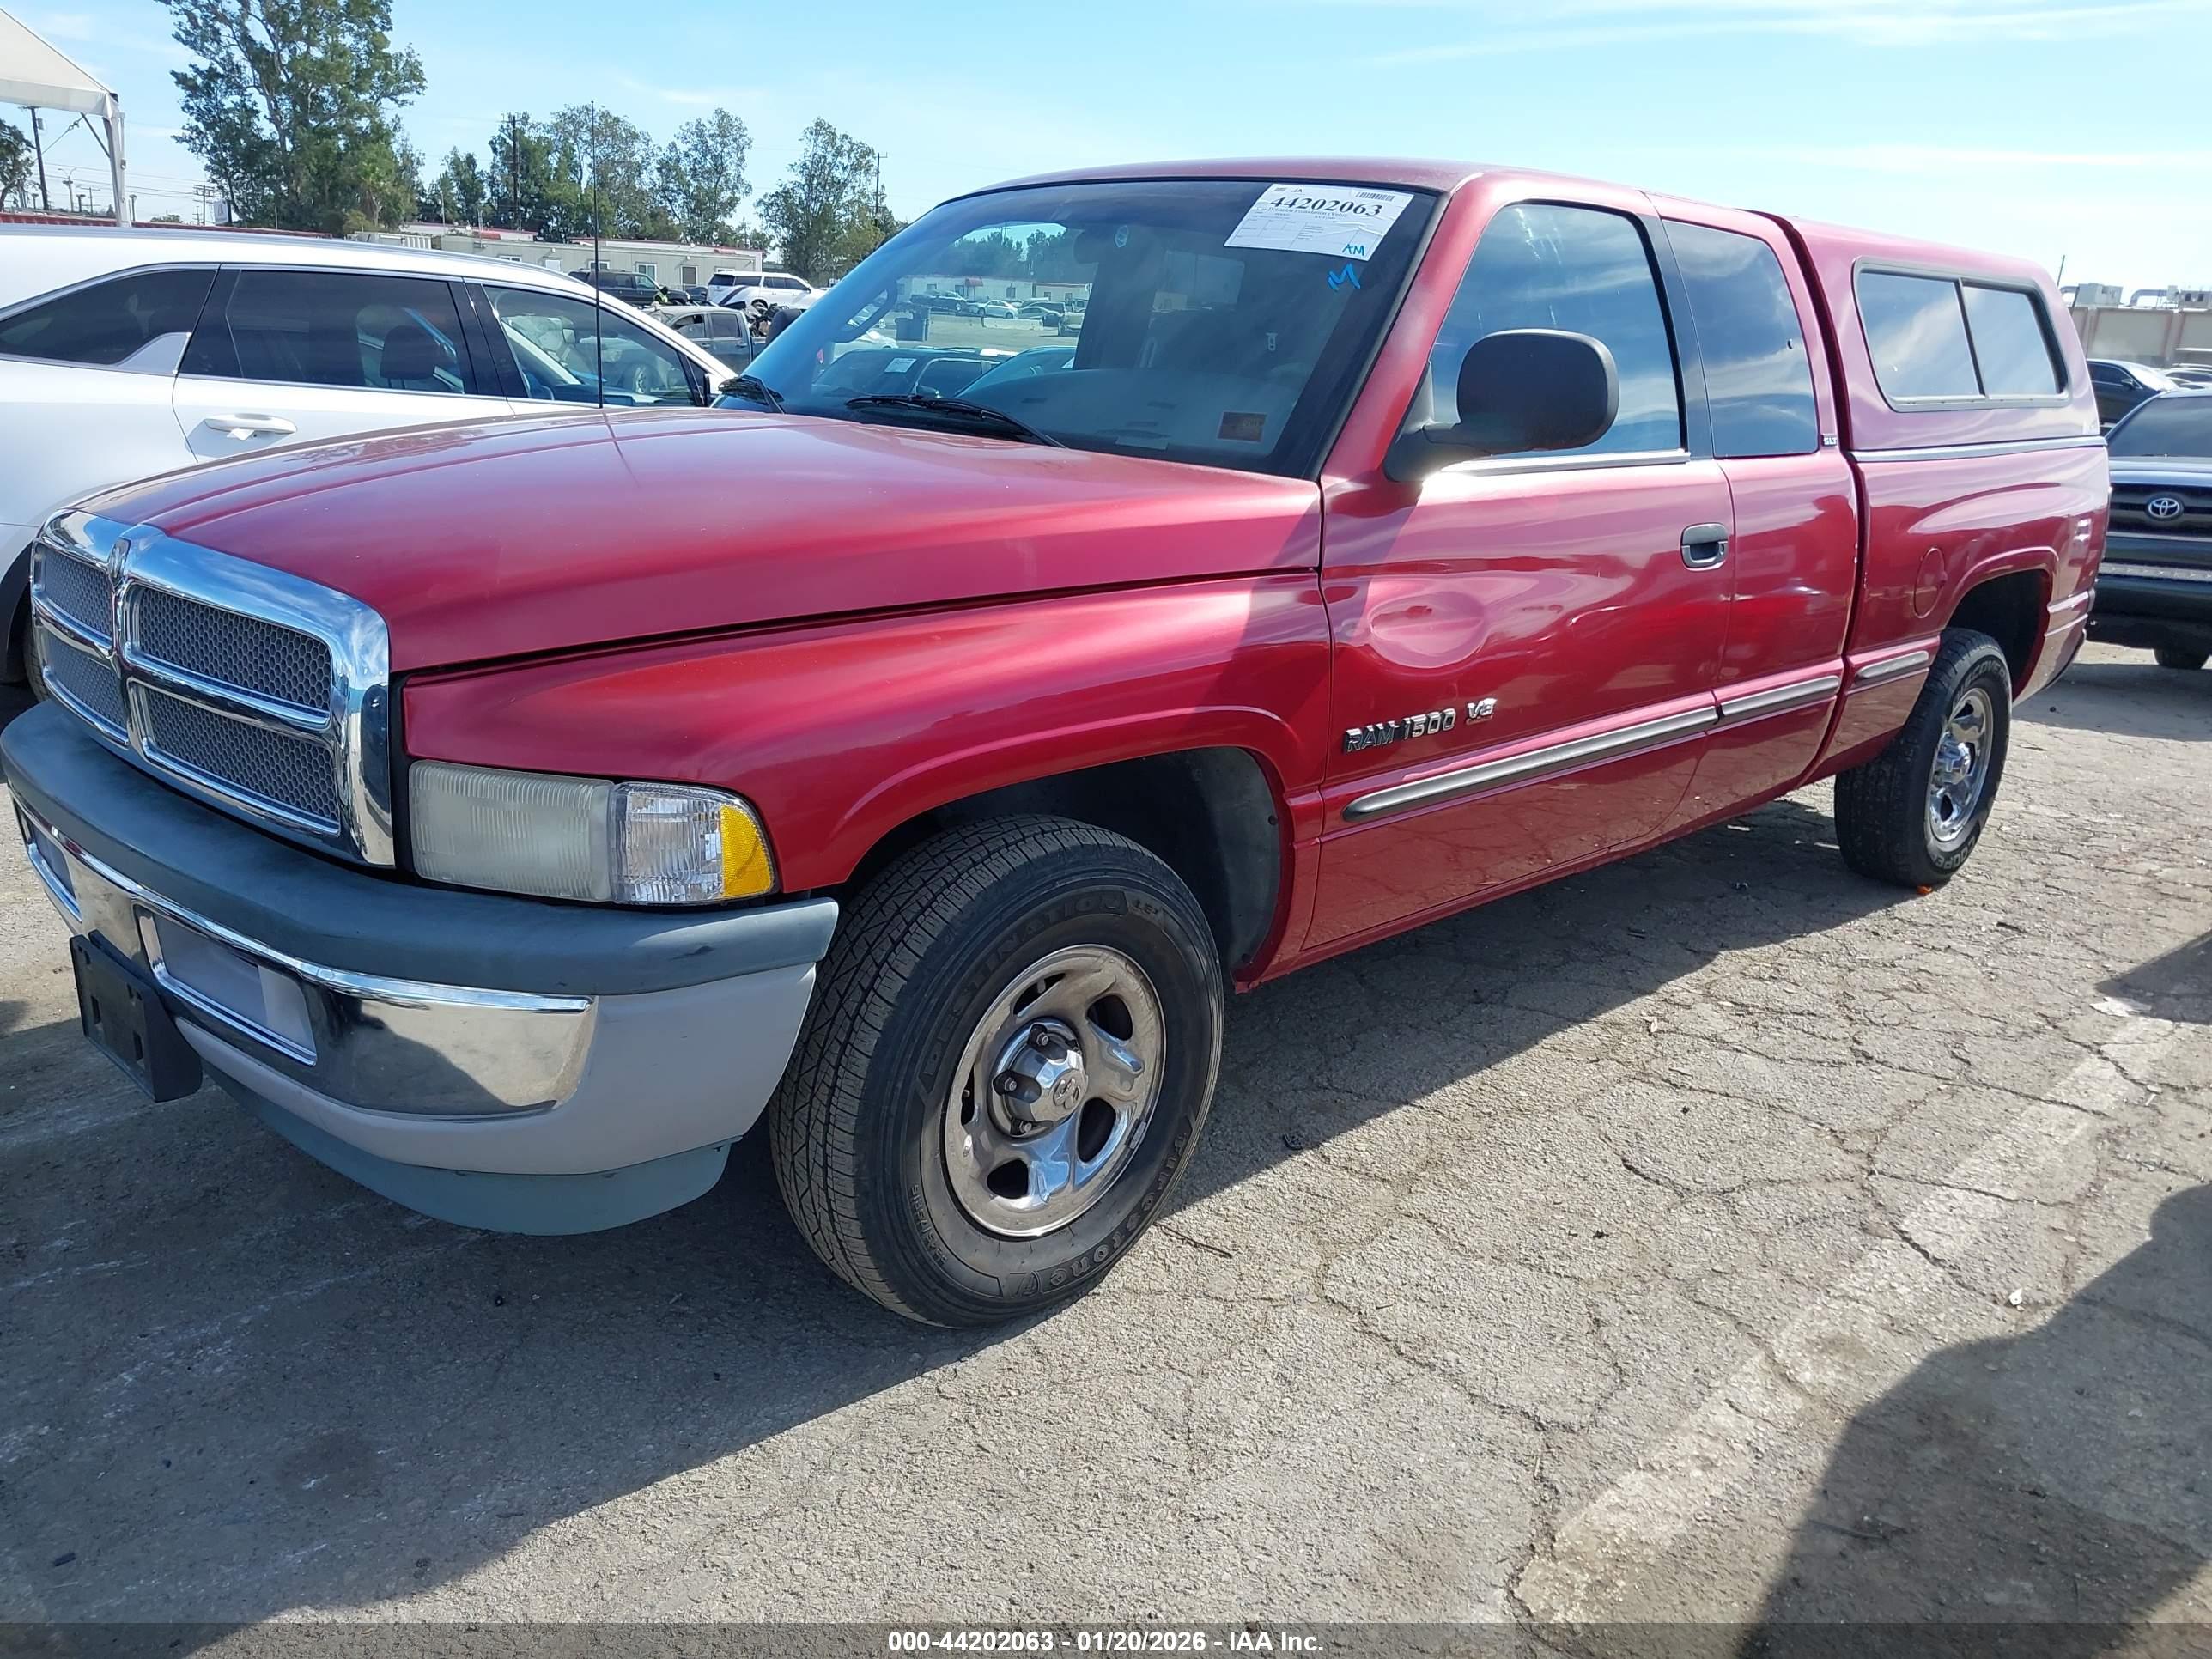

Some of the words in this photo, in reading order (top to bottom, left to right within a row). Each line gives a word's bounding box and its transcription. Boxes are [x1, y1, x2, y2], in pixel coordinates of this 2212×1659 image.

[1270, 197, 1382, 216] 44202063
[1342, 243, 1365, 257] AM
[1343, 720, 1398, 752] RAM
[1402, 708, 1457, 740] 1500
[1467, 697, 1497, 719] V8
